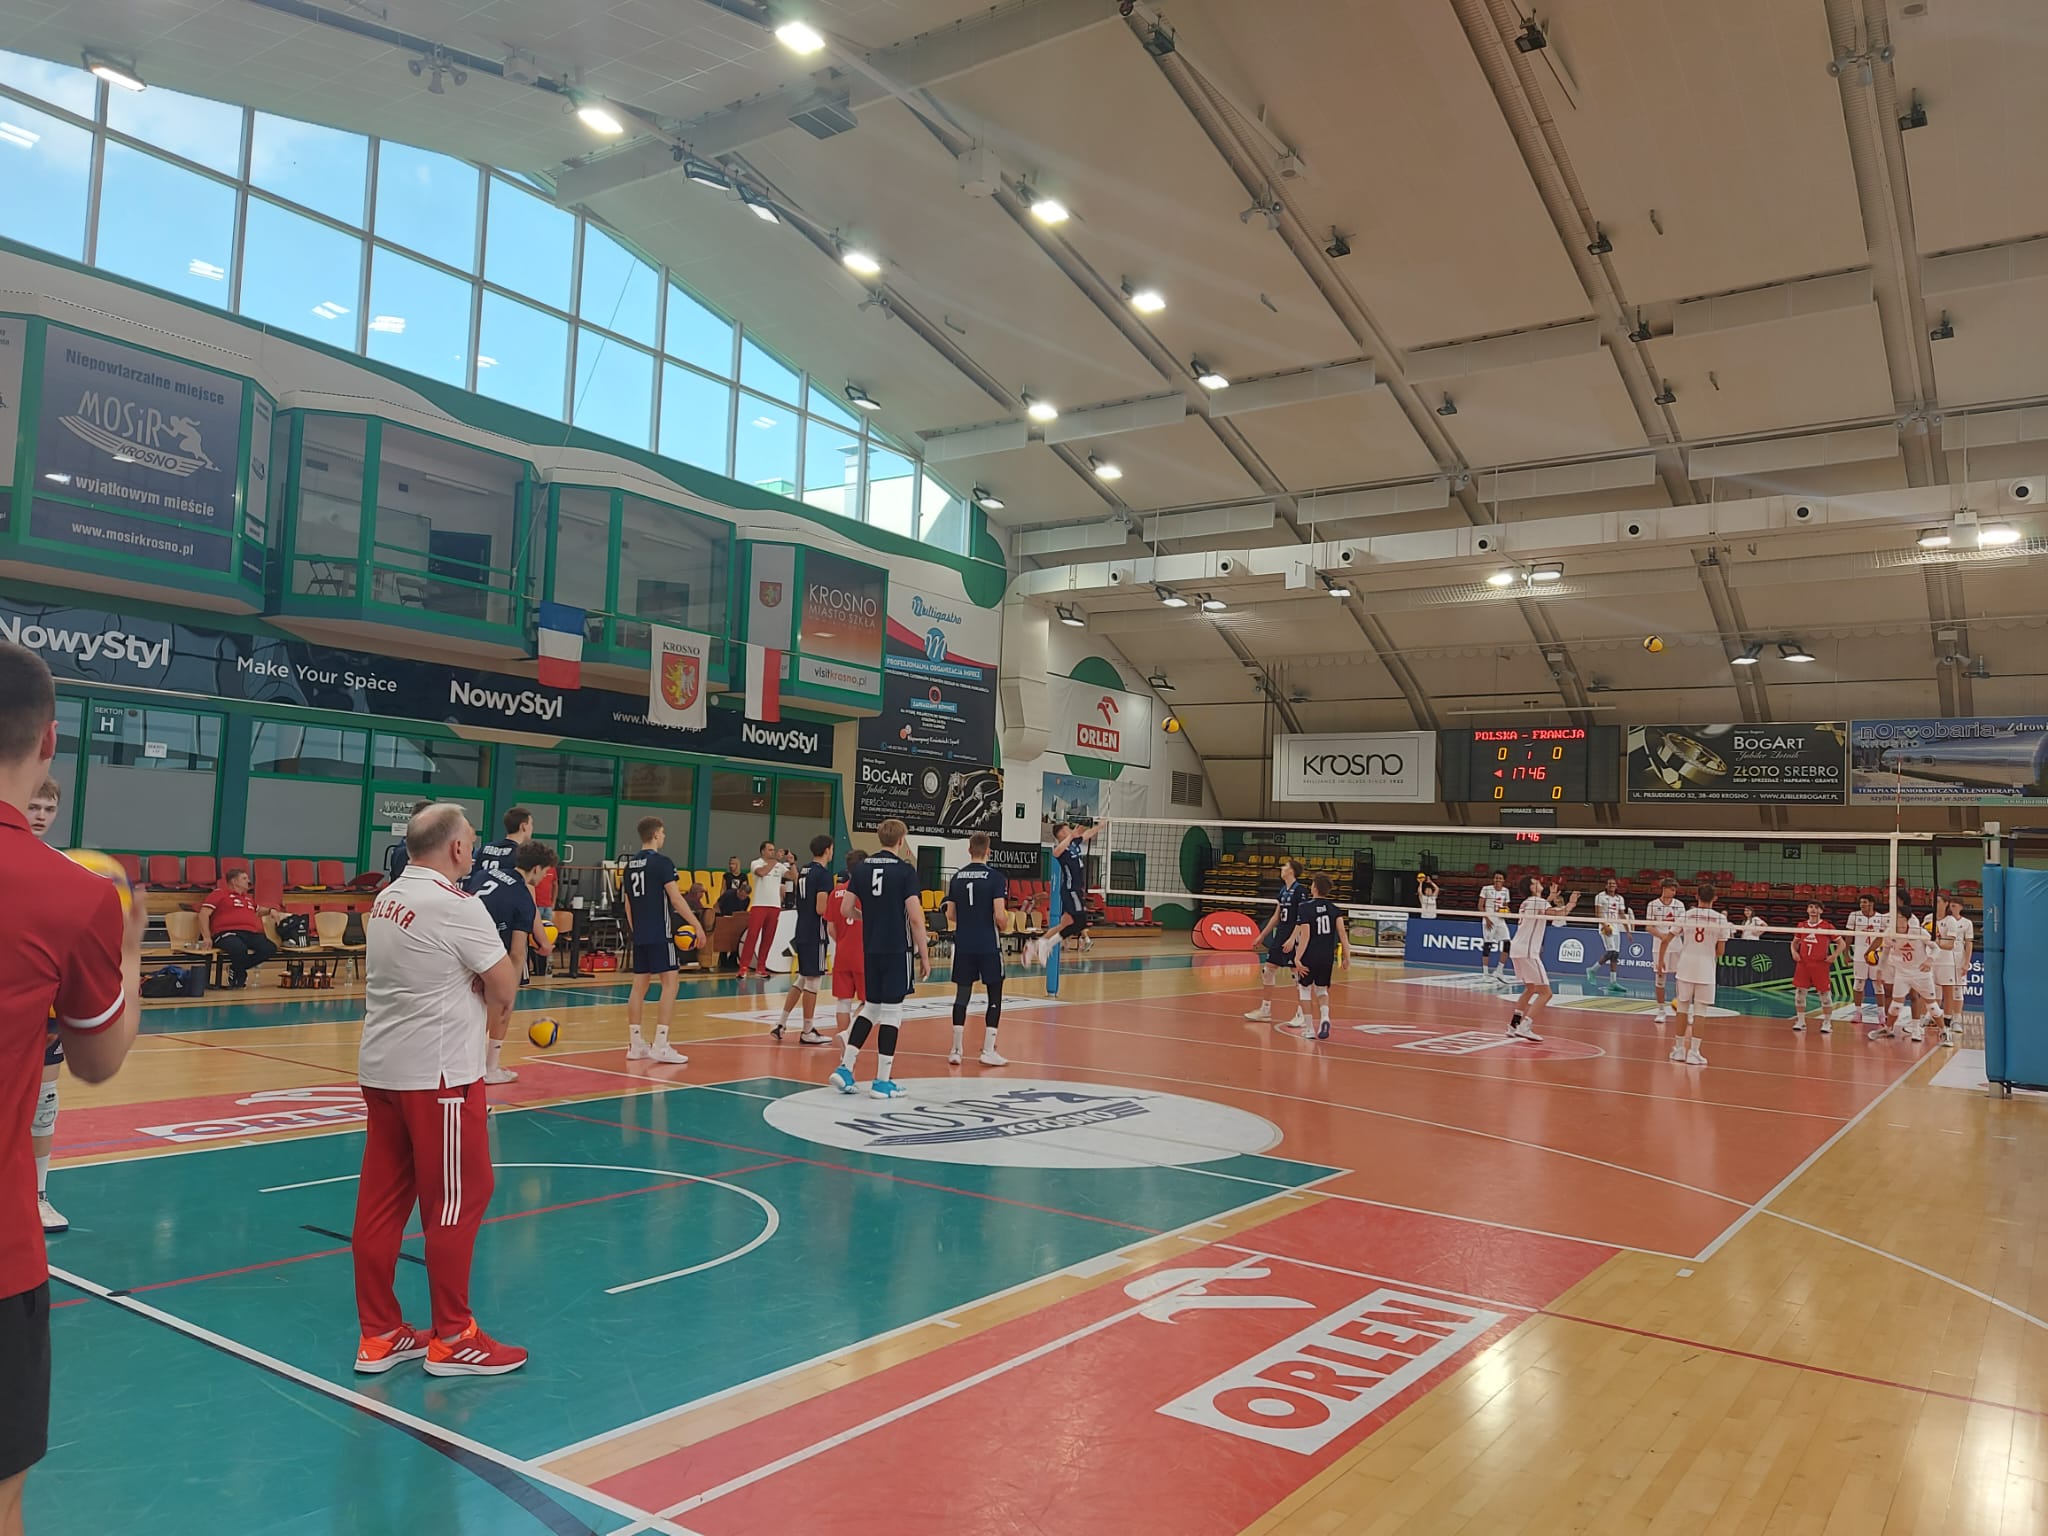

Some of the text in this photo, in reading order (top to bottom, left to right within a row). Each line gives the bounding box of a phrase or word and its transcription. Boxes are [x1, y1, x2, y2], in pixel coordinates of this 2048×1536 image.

[66, 348, 225, 406] Niepowtarzalne miejsce
[78, 390, 162, 448] MOSiR
[117, 443, 178, 471] KROSNO
[75, 476, 160, 505] wyjątkowym
[163, 498, 215, 518] mieście
[71, 521, 194, 556] www.mosirkrosno.pl
[808, 584, 877, 617] KROSNO
[912, 596, 961, 624] Multigastro
[808, 604, 876, 629] MIASTO SZKŁA
[662, 641, 700, 655] KROSNO
[237, 656, 398, 693] Make Your Space
[814, 668, 867, 686] visitkrosno.pl
[95, 706, 123, 715] SEKTOR
[450, 680, 562, 720] NowyStyl
[100, 717, 114, 732] H
[1474, 731, 1518, 740] POLSKA
[1532, 729, 1585, 740] FRANCJA
[742, 723, 818, 753] NowyStyl
[1079, 727, 1117, 749] ORLEN
[1498, 747, 1507, 760] 0
[1552, 746, 1562, 760] 0
[1733, 765, 1839, 777] ZŁOTO SREBRO
[1494, 786, 1562, 799] 0 0
[1328, 835, 1340, 844] G1
[988, 849, 1038, 864] EROWATCH
[1785, 848, 1799, 858] F2
[477, 880, 499, 896] 2
[631, 870, 646, 897] 21
[872, 869, 884, 896] 5
[966, 882, 974, 906] 1
[372, 897, 417, 931] OLSKA
[1316, 915, 1330, 935] 10
[1225, 925, 1252, 936] ORLEN
[1562, 949, 1581, 957] UNIA
[1718, 955, 1747, 967] lus
[1806, 943, 1813, 957] 7
[171, 1108, 367, 1137] ORL
[999, 1110, 1116, 1136] KROSNO
[1212, 1299, 1477, 1429] ORLEN
